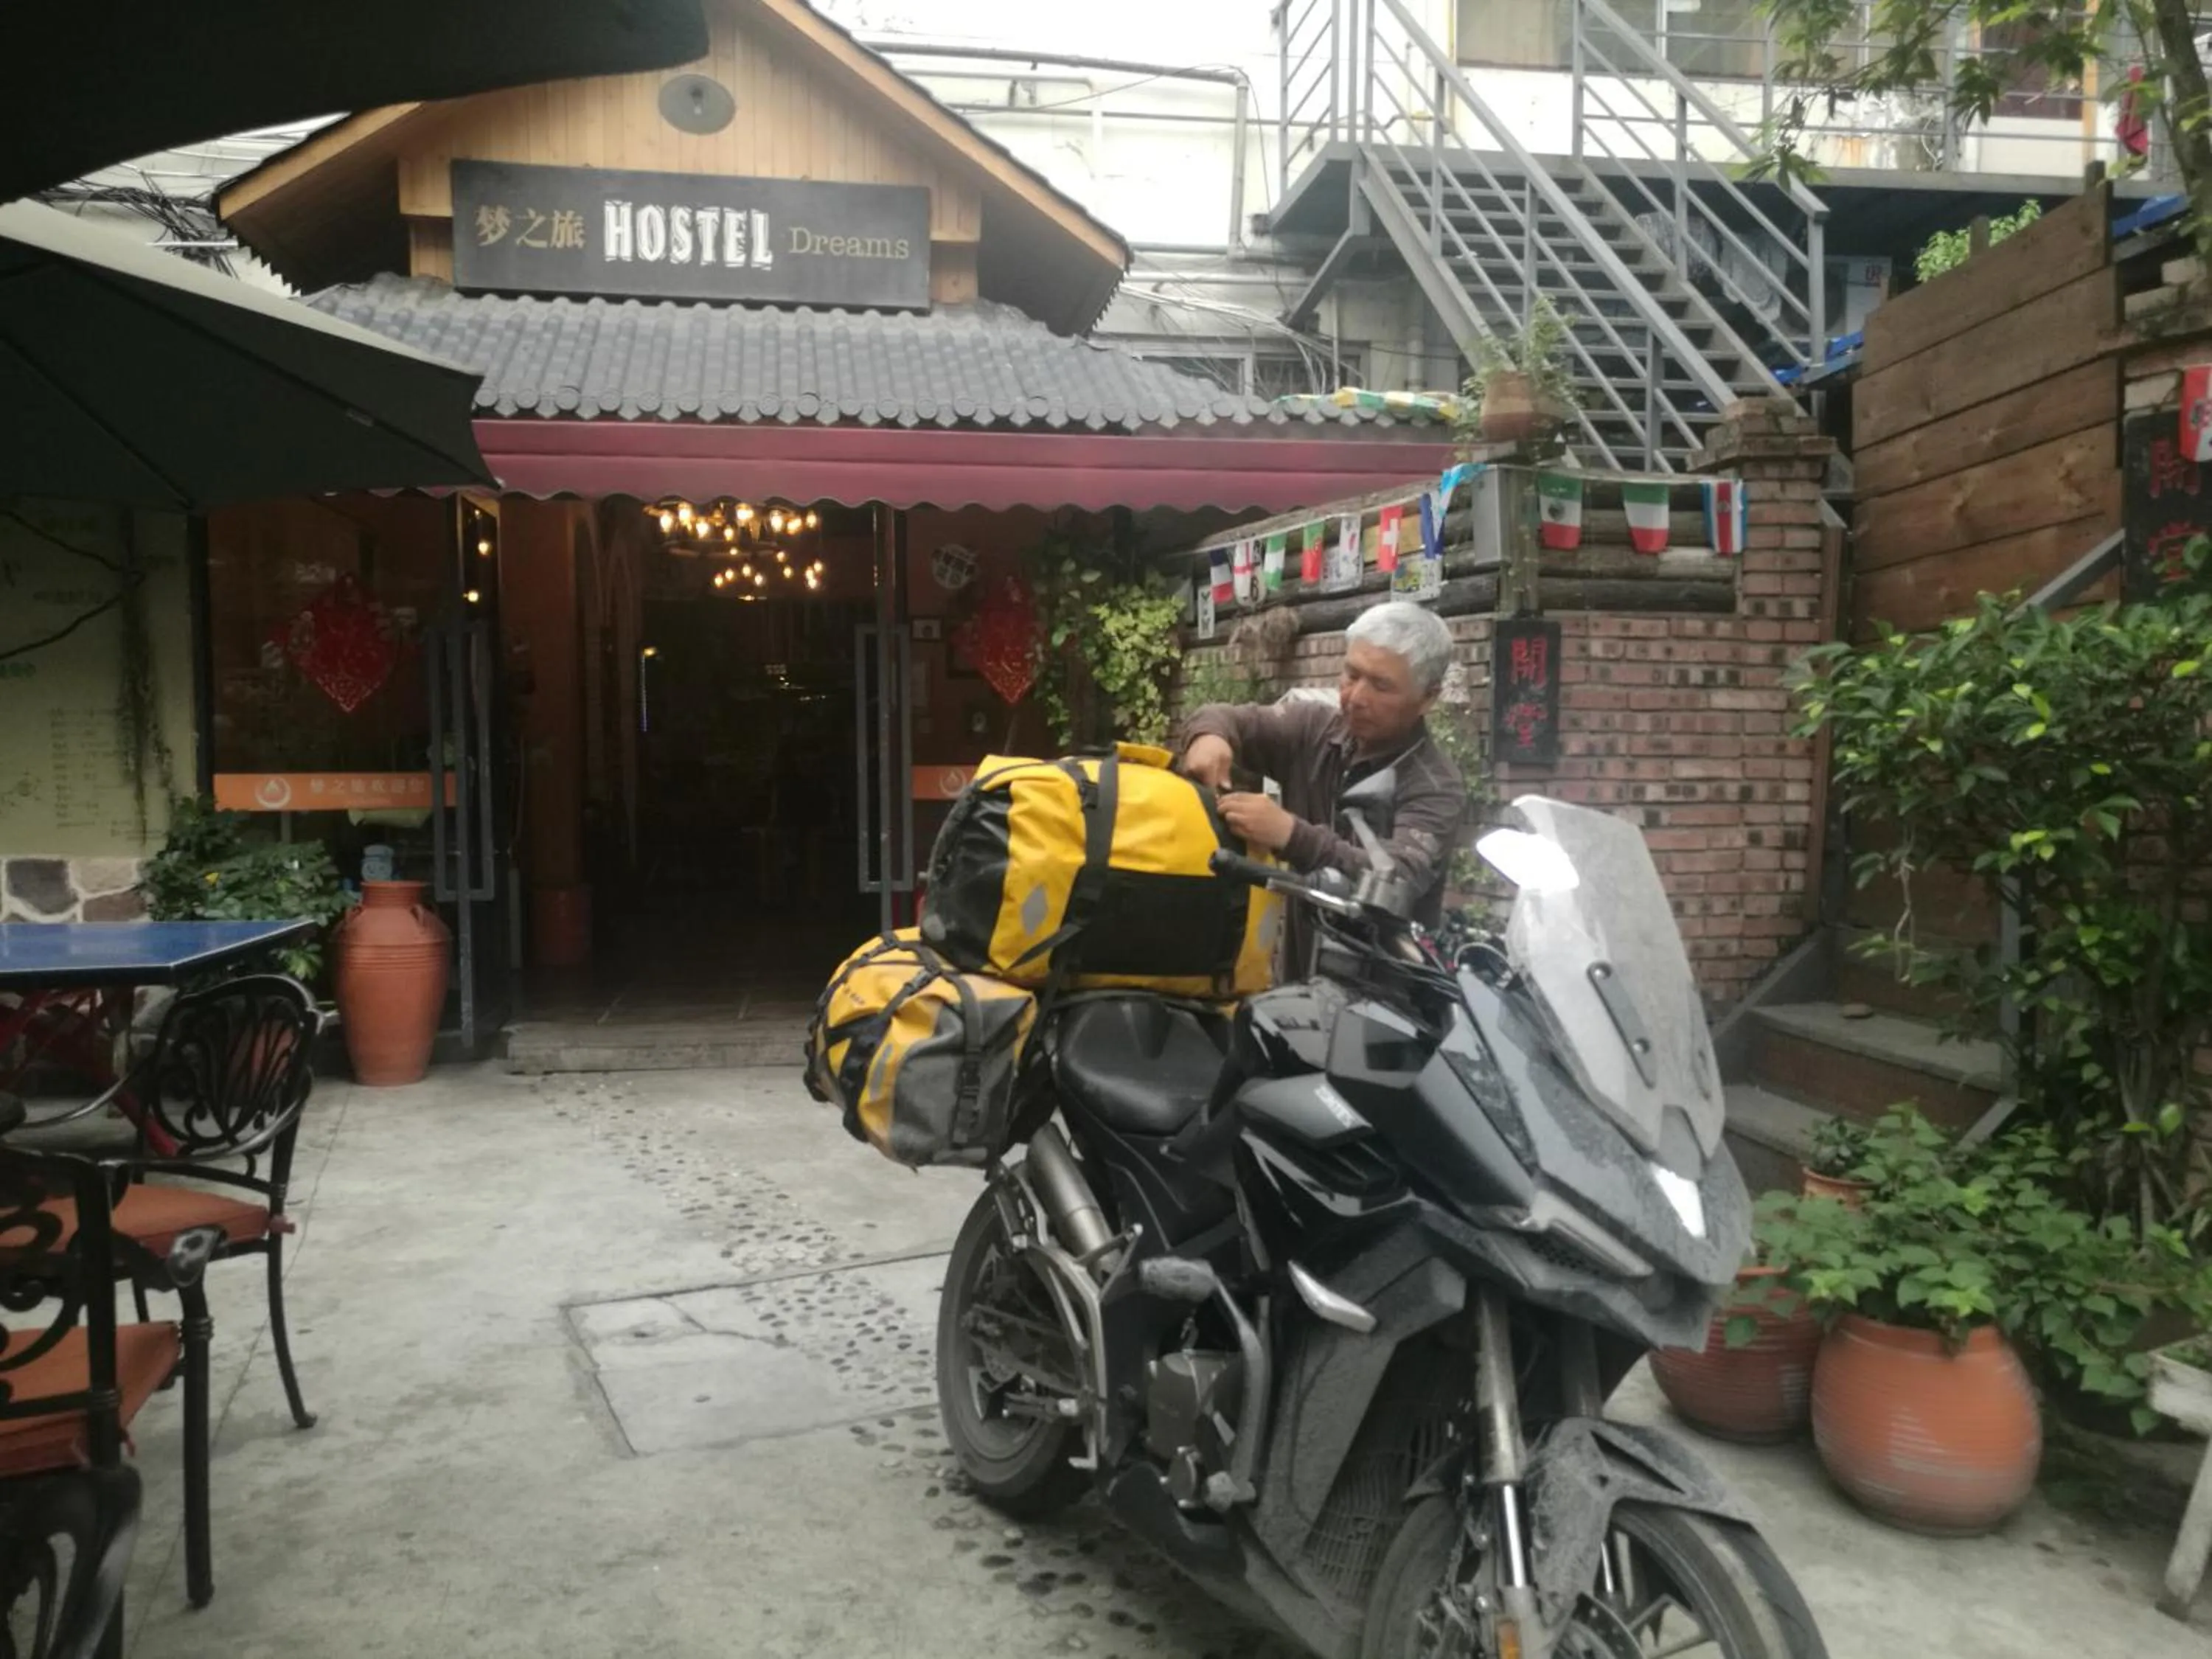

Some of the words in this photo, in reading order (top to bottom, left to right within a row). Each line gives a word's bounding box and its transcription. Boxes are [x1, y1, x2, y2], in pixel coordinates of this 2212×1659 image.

[475, 205, 585, 248] 梦之旅
[604, 200, 773, 271] HOSTEL
[788, 226, 909, 259] Dreams
